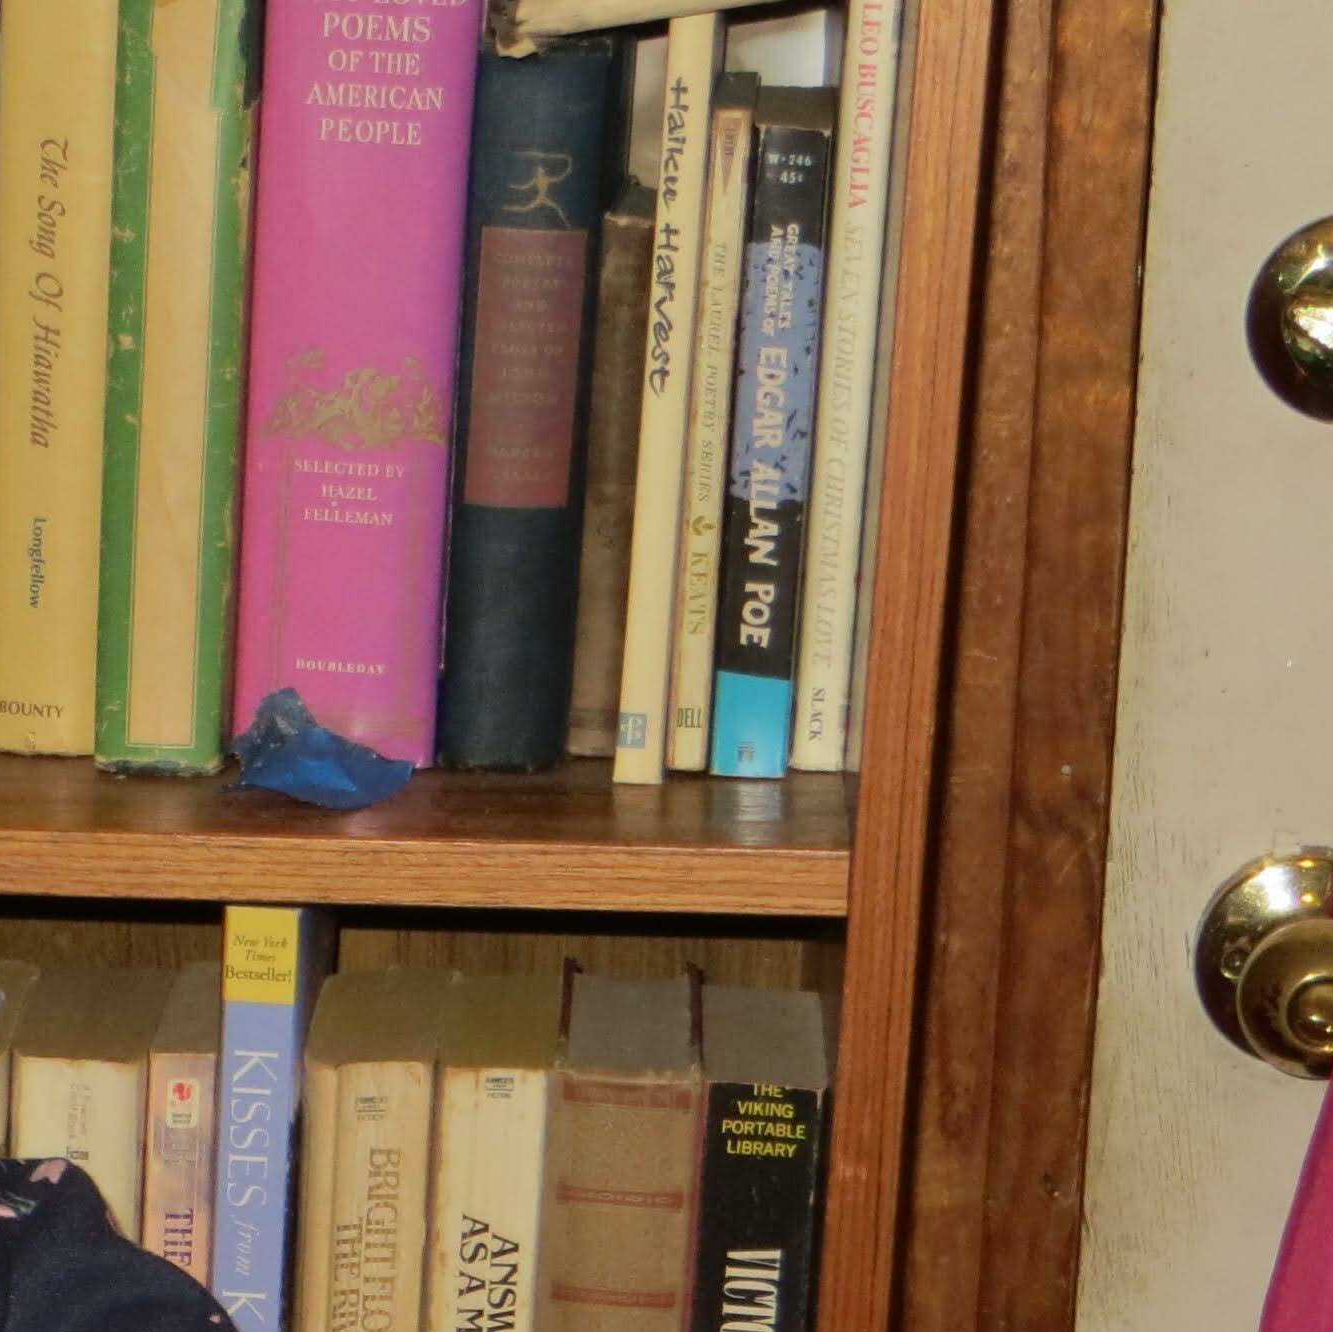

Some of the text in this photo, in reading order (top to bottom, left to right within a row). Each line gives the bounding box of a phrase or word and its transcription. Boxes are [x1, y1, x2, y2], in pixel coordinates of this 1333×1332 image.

[324, 12, 431, 43] POEMS
[328, 49, 420, 76] OF THE
[306, 83, 444, 112] AMERICAN
[847, 3, 882, 208] LEO BUSCAGLIA
[319, 118, 422, 145] PEOPLE
[29, 137, 68, 449] The Song Of Hiawatha
[649, 223, 682, 396] Harvest
[294, 458, 405, 478] SELECTED BY
[321, 484, 377, 501] HAZEL
[740, 347, 788, 649] EDGAR ALLAN POE
[304, 508, 394, 526] FELLEMAN
[688, 440, 716, 636] SERIES KEATS
[29, 517, 47, 608] Longfellow
[295, 658, 386, 675] DOUBLEDAY
[0, 700, 65, 719] BOUNTY
[676, 707, 702, 729] DELL
[807, 688, 826, 741] SLACK
[234, 934, 288, 949] New York
[245, 949, 277, 963] Times
[225, 964, 292, 983] Bestseller!
[753, 1082, 783, 1097] THE
[737, 1101, 795, 1119] VIKING
[228, 1048, 278, 1207] KISSES
[722, 1120, 806, 1139] PORTABLE
[727, 1140, 797, 1158] LIBRARY
[365, 1147, 400, 1266] BRIGHT
[232, 1217, 259, 1276] from
[334, 1219, 361, 1282] THE
[460, 1214, 489, 1265] AS
[457, 1272, 486, 1295] A
